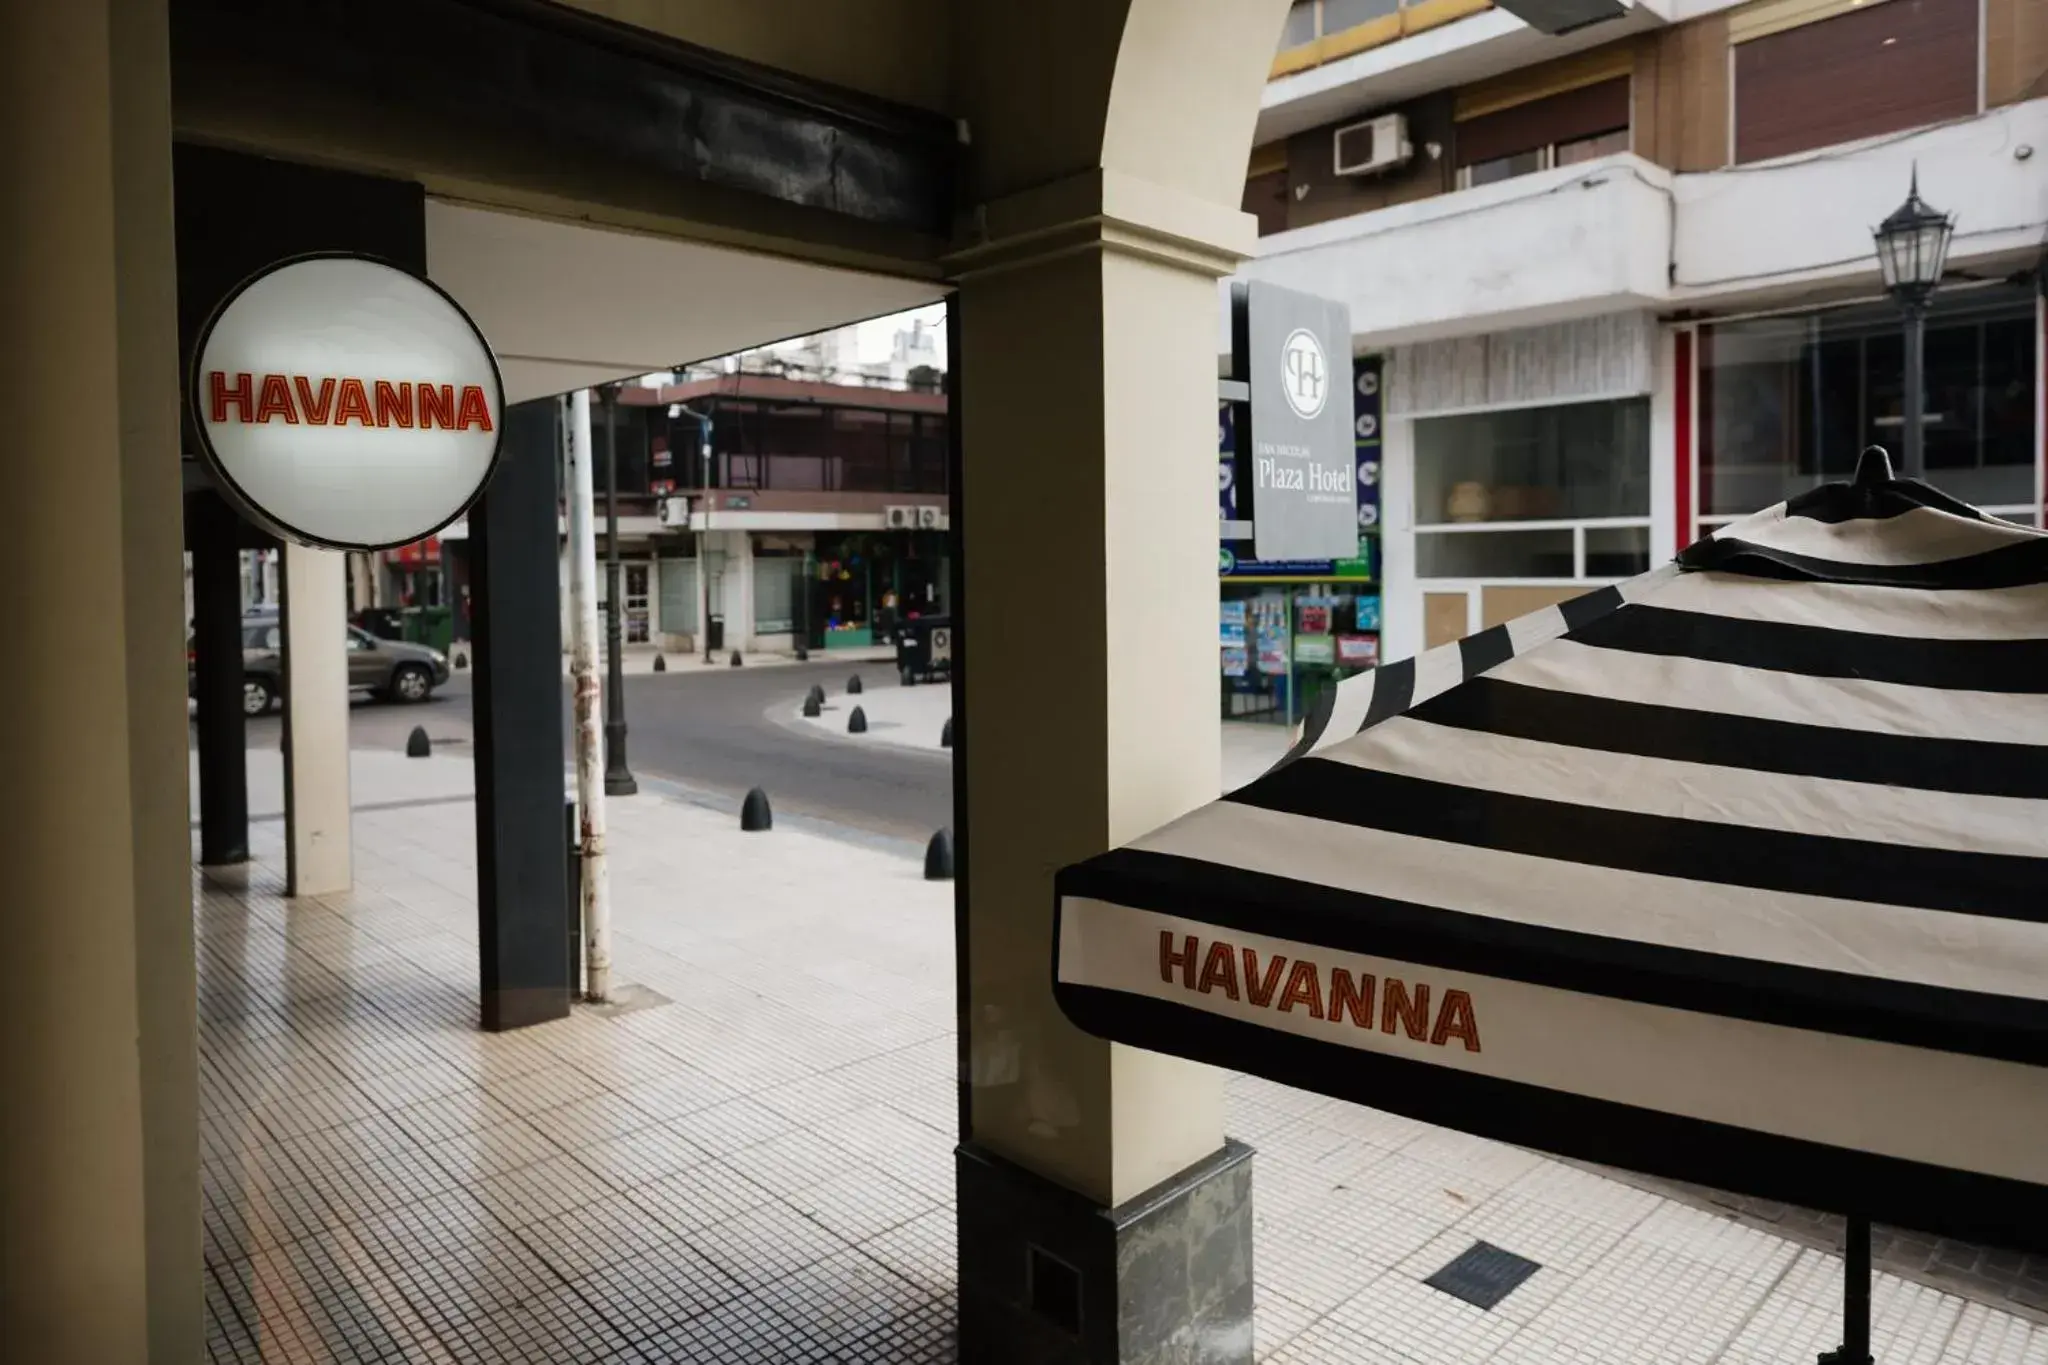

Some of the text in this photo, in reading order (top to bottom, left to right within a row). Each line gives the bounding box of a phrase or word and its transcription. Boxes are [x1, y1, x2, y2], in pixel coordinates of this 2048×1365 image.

[209, 371, 493, 432] HAVANNA
[1259, 457, 1352, 493] Plaza Hotel
[1160, 930, 1481, 1053] HAVANNA
